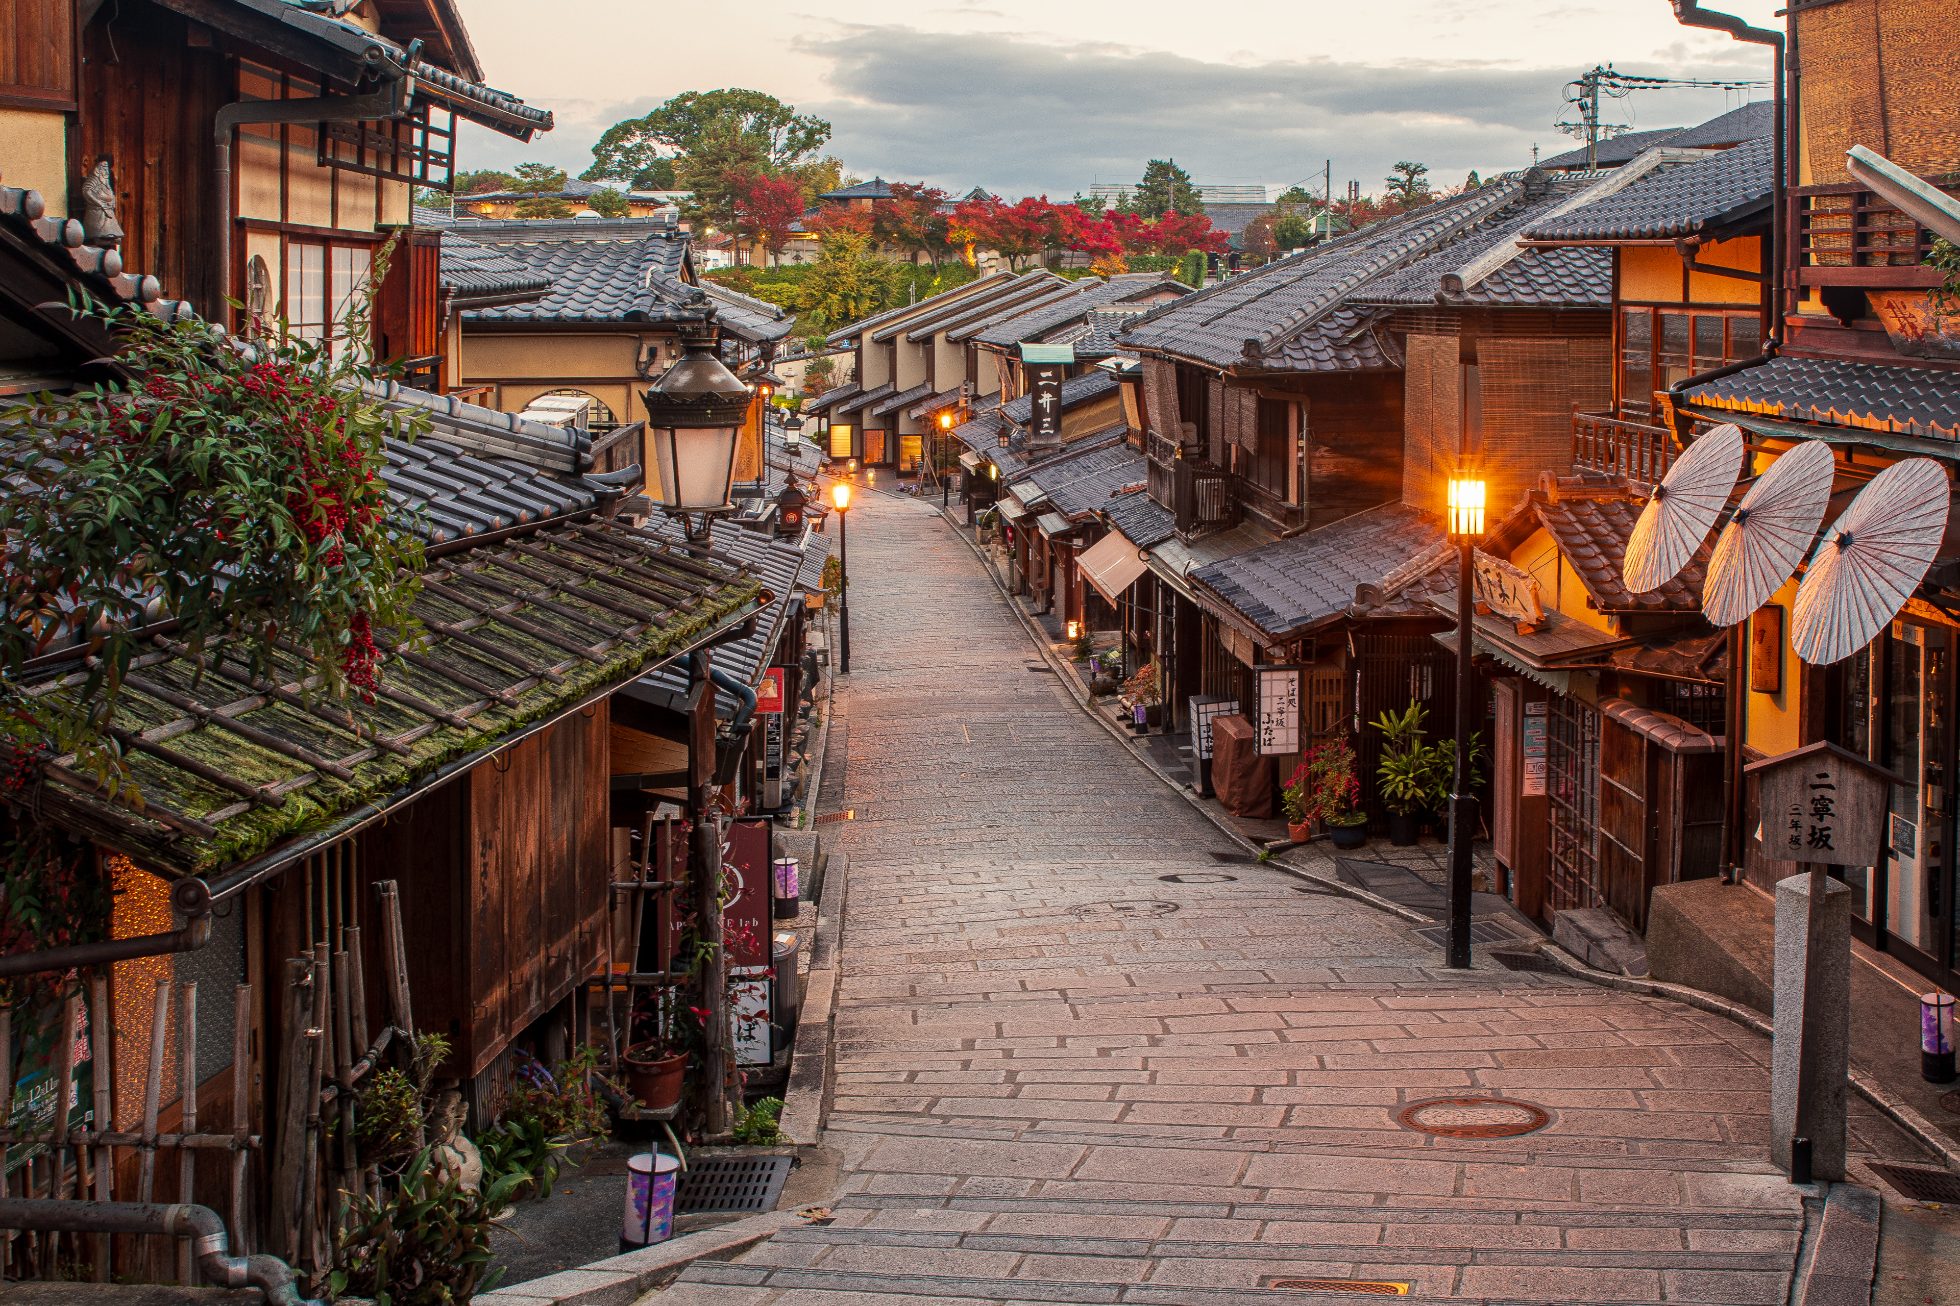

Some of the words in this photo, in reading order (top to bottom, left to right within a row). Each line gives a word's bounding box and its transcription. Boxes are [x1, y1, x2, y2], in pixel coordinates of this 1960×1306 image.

[1287, 677, 1297, 708] そば処
[1262, 713, 1276, 747] ふたば
[1807, 772, 1836, 850] 二寧坂
